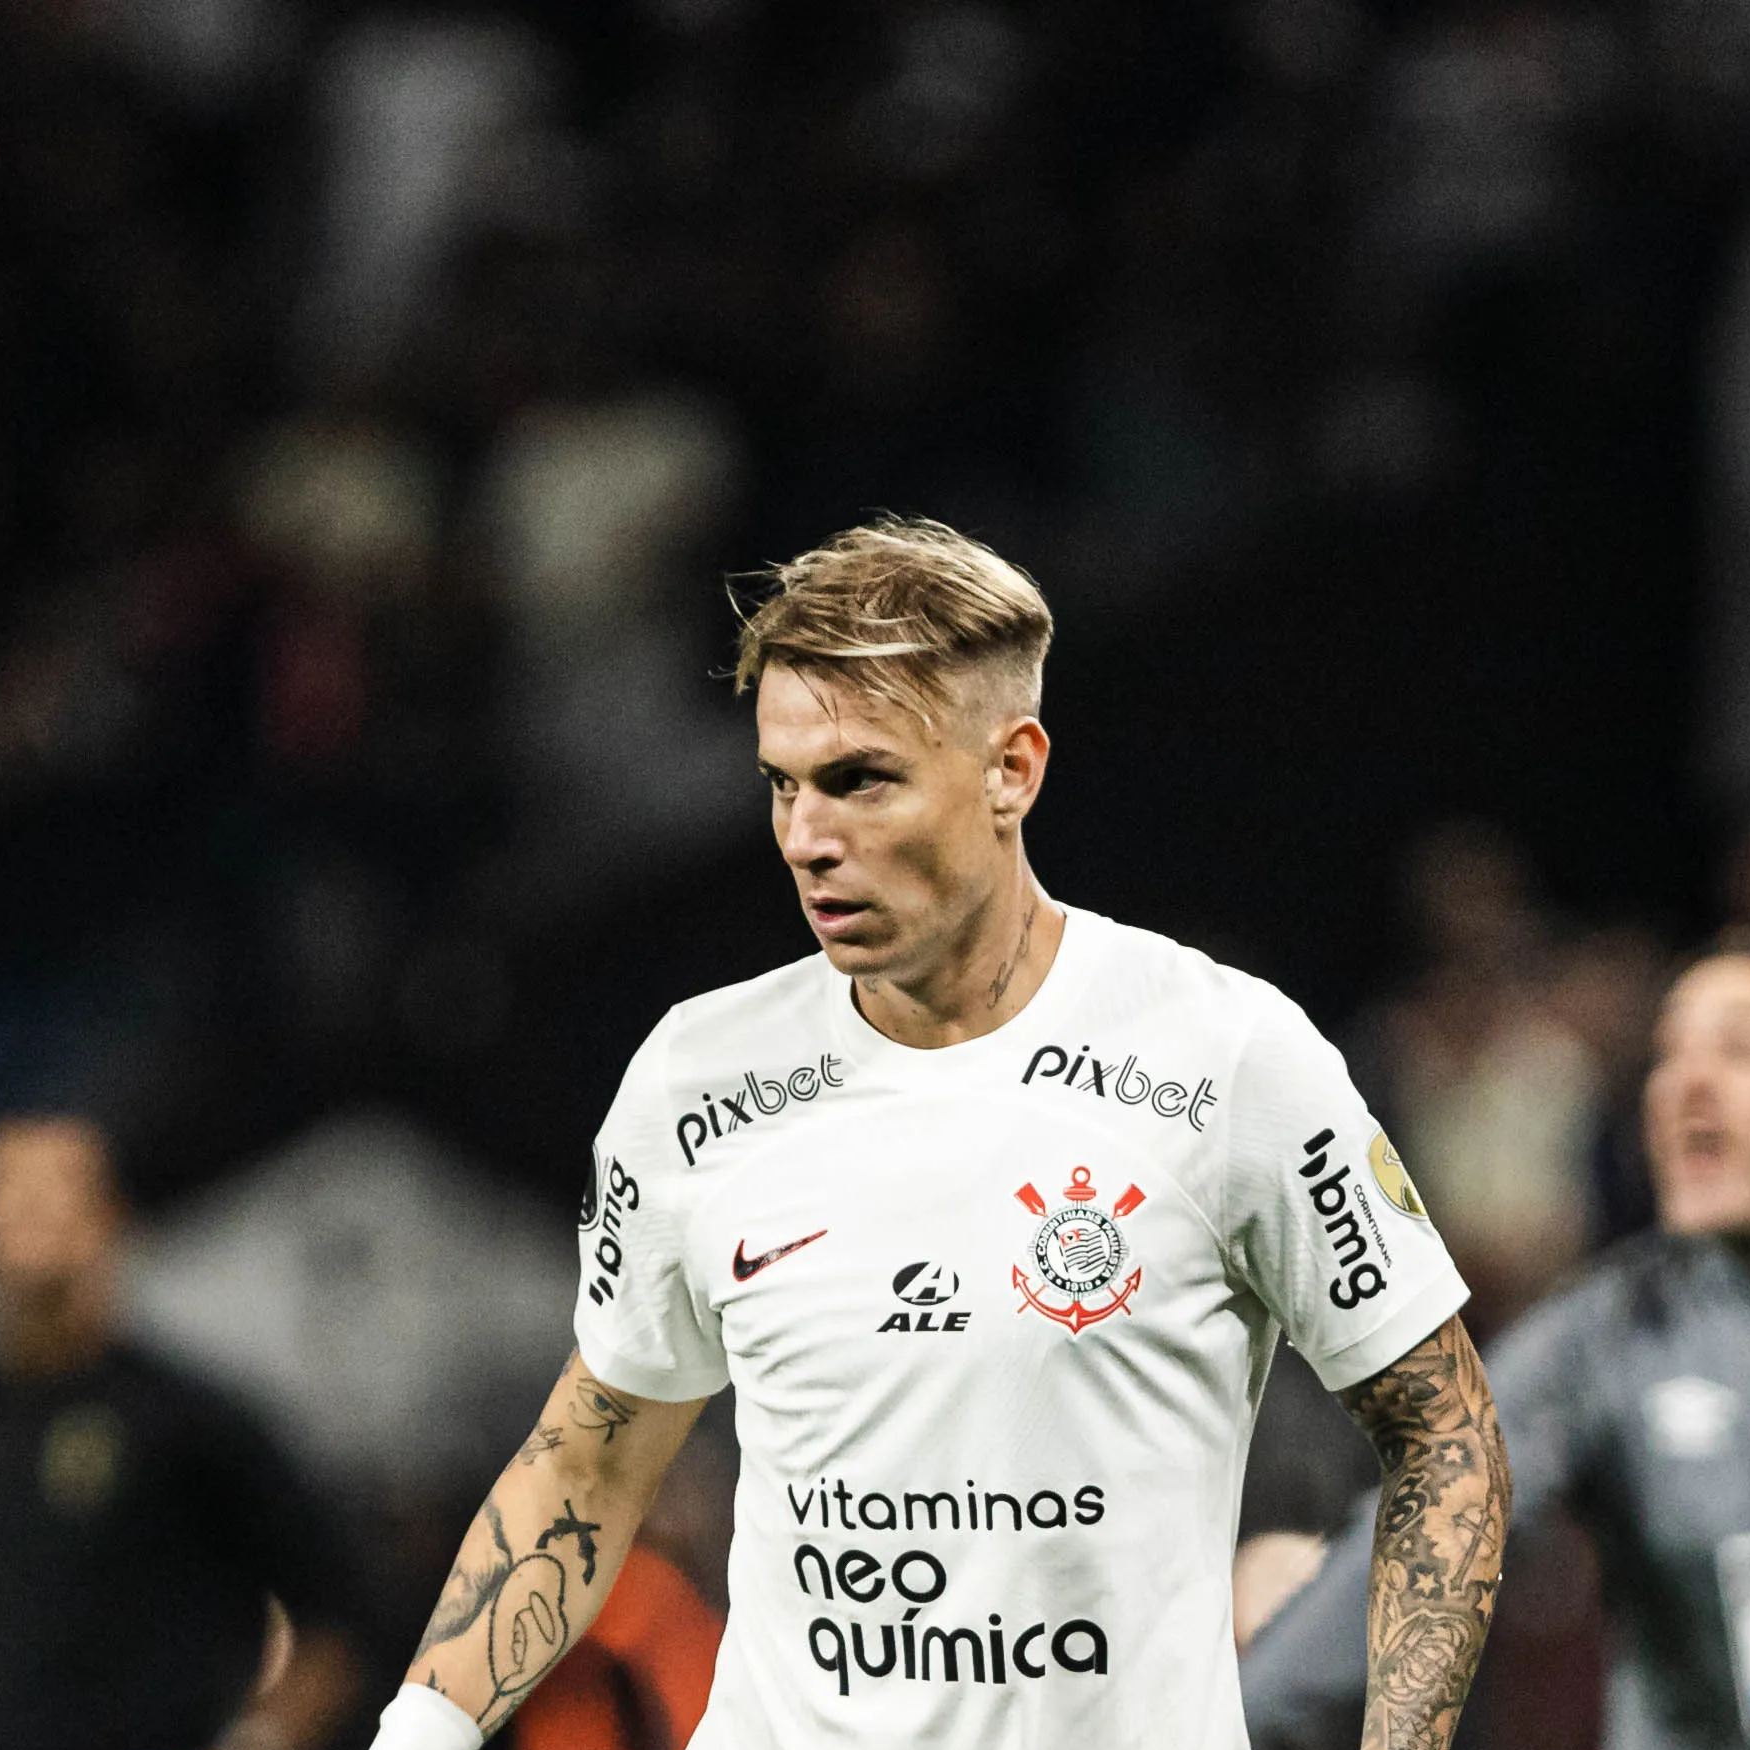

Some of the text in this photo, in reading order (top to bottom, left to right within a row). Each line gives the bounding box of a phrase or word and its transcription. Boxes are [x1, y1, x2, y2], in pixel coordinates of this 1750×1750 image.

[676, 1053, 843, 1167] pixbet
[1021, 1045, 1218, 1133] pixbet
[595, 1154, 640, 1278] bmg
[1036, 1209, 1104, 1257] CORINTHIANS
[1308, 1164, 1387, 1310] bmg
[1353, 1184, 1393, 1268] CORINTHIANS
[876, 1312, 972, 1333] ALE
[787, 1478, 1105, 1532] vitaminas
[793, 1543, 947, 1604] neo
[808, 1608, 1108, 1697] química
